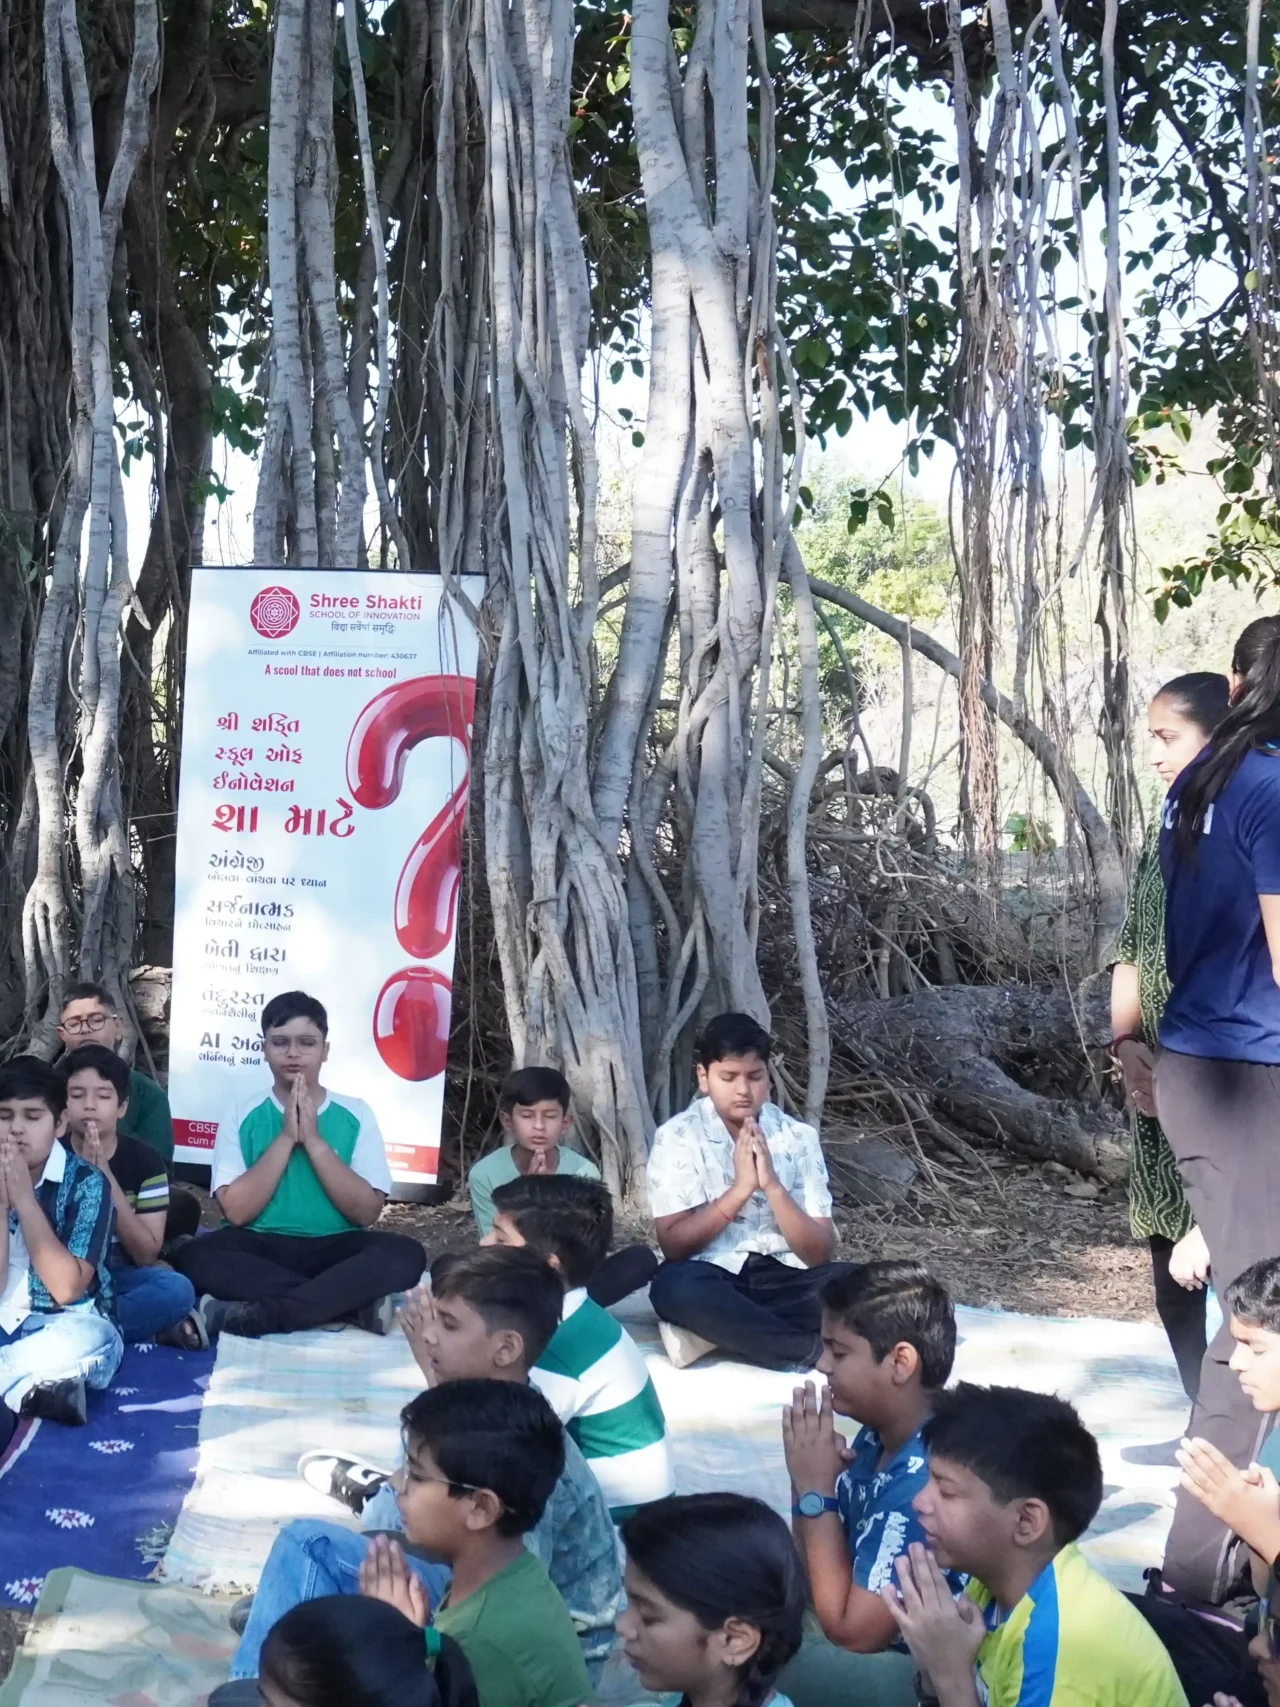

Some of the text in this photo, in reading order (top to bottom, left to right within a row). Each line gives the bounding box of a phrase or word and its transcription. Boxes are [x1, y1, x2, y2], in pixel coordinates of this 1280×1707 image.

[310, 593, 422, 610] Shree Shakti
[309, 611, 346, 619] SCHOOL
[363, 612, 421, 620] INNOVATION
[247, 649, 279, 657] Affiliated
[358, 651, 389, 659] number:
[264, 664, 397, 679] A scool that does not school
[216, 711, 239, 731] શ્રી
[213, 770, 295, 792] ઈનોવેશન
[211, 796, 356, 838] શા માટે
[208, 849, 265, 873] અંગ્રેજી
[281, 876, 296, 887] પર
[300, 877, 327, 888] ધ્યાન
[206, 894, 295, 918] સર્જનાત્મક
[204, 938, 239, 959] ખેતી
[199, 1031, 221, 1048] AI
[188, 1121, 218, 1135] CBSE
[187, 1136, 209, 1146] cum
